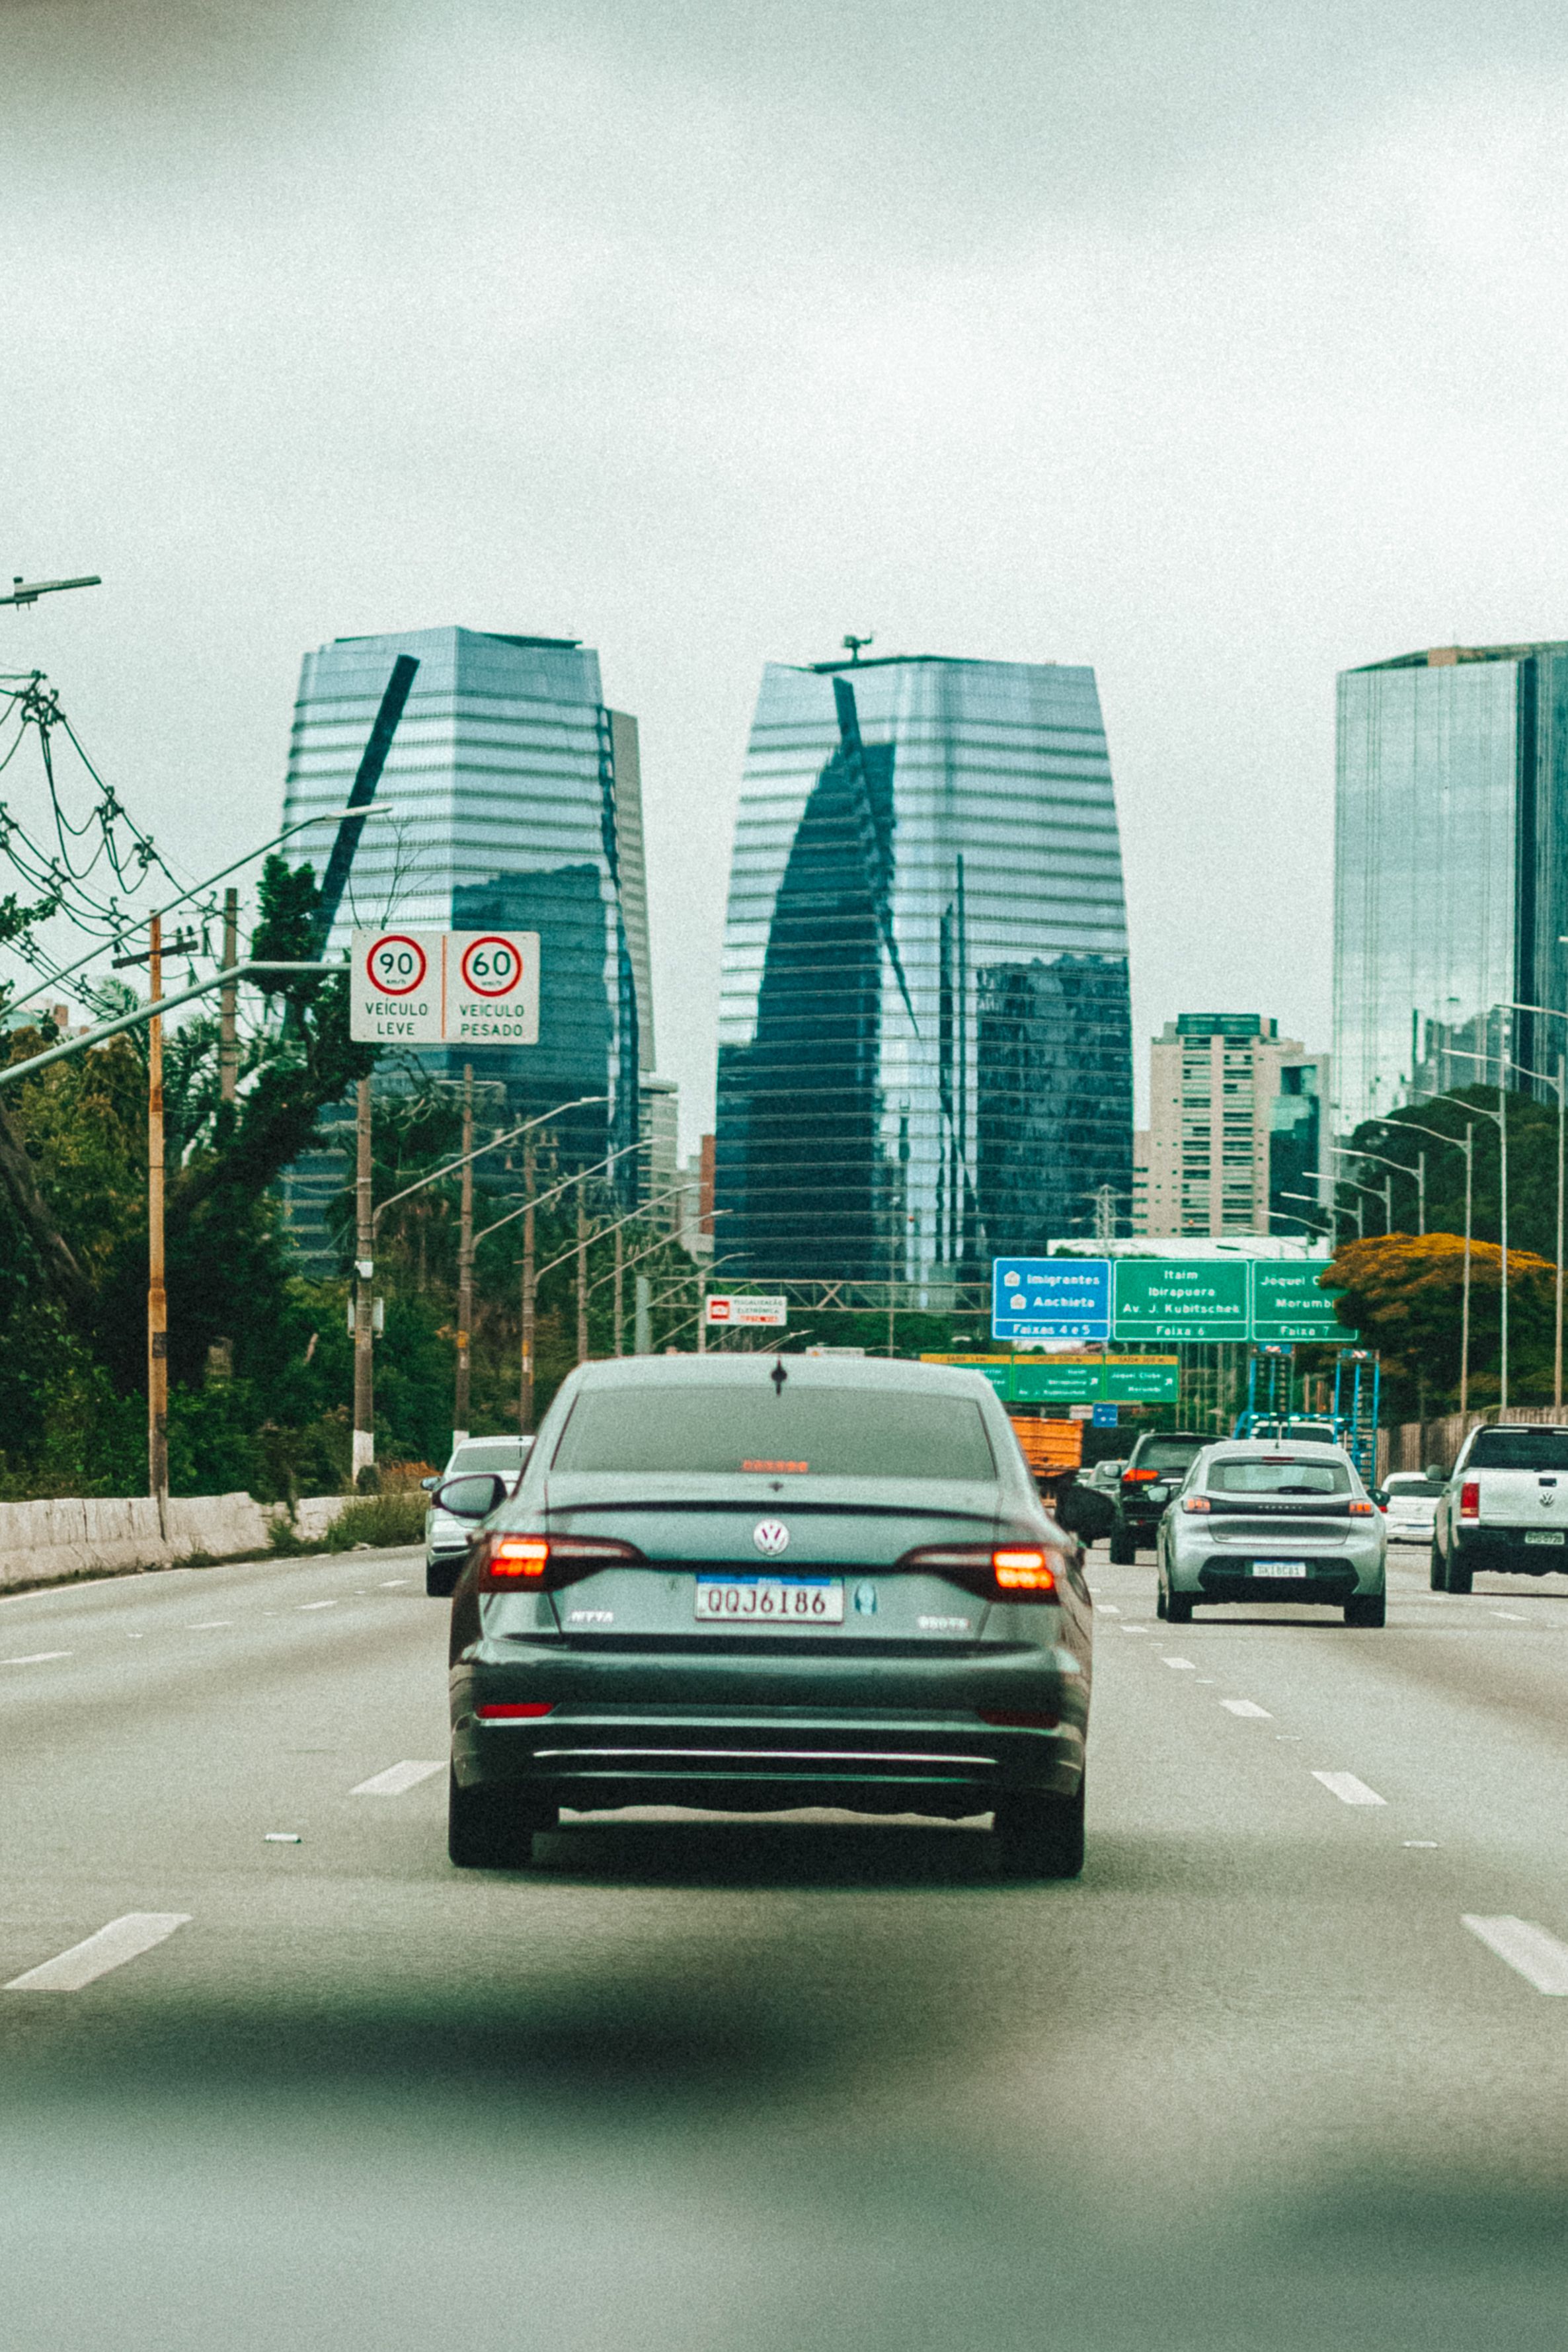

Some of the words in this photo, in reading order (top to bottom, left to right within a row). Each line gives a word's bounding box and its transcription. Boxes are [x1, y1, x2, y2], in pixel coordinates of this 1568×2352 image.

[380, 953, 413, 974] 90
[473, 951, 511, 976] 60
[366, 998, 428, 1016] VEÍCULO
[377, 1022, 415, 1035] LEVE
[461, 1024, 523, 1037] PESADO
[1027, 1274, 1100, 1287] Imigrantes
[1163, 1269, 1198, 1279] Itaim
[1148, 1286, 1216, 1299] Ibirapuera
[1033, 1296, 1095, 1308] Anchieta
[1013, 1323, 1054, 1335] Faixas
[1059, 1324, 1068, 1334] 4
[1081, 1324, 1091, 1335] 5
[1156, 1325, 1191, 1335] Faixa
[1198, 1327, 1205, 1335] 6
[1280, 1326, 1316, 1336] Faixa
[1323, 1326, 1329, 1336] 7
